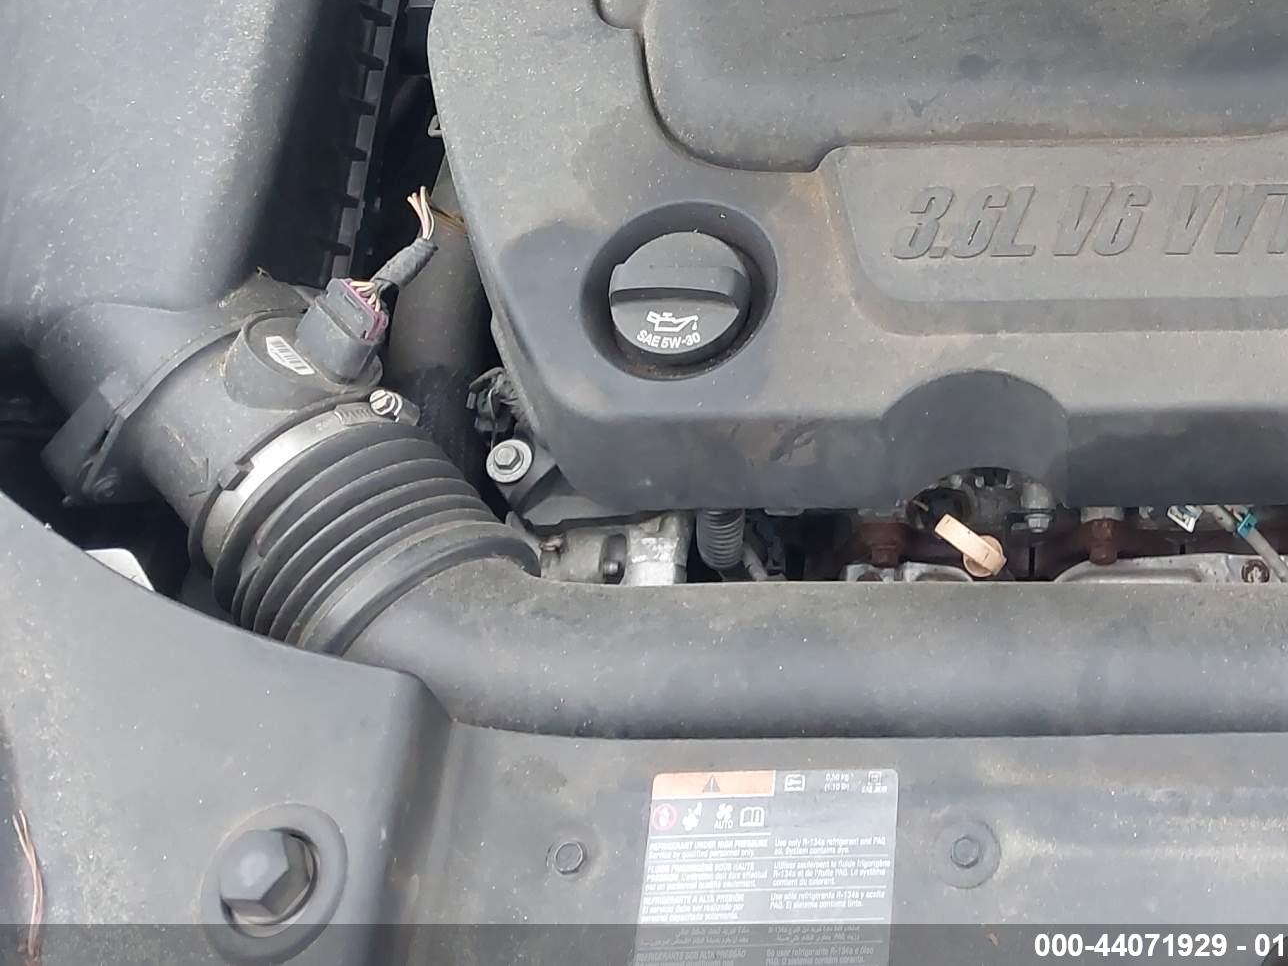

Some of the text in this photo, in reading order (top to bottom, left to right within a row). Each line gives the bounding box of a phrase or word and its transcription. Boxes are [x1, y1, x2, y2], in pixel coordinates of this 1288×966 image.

[891, 185, 1037, 259] 3.6L
[1053, 183, 1152, 257] V6
[637, 330, 701, 349] SAE 5W-30
[714, 820, 734, 829] AUTO
